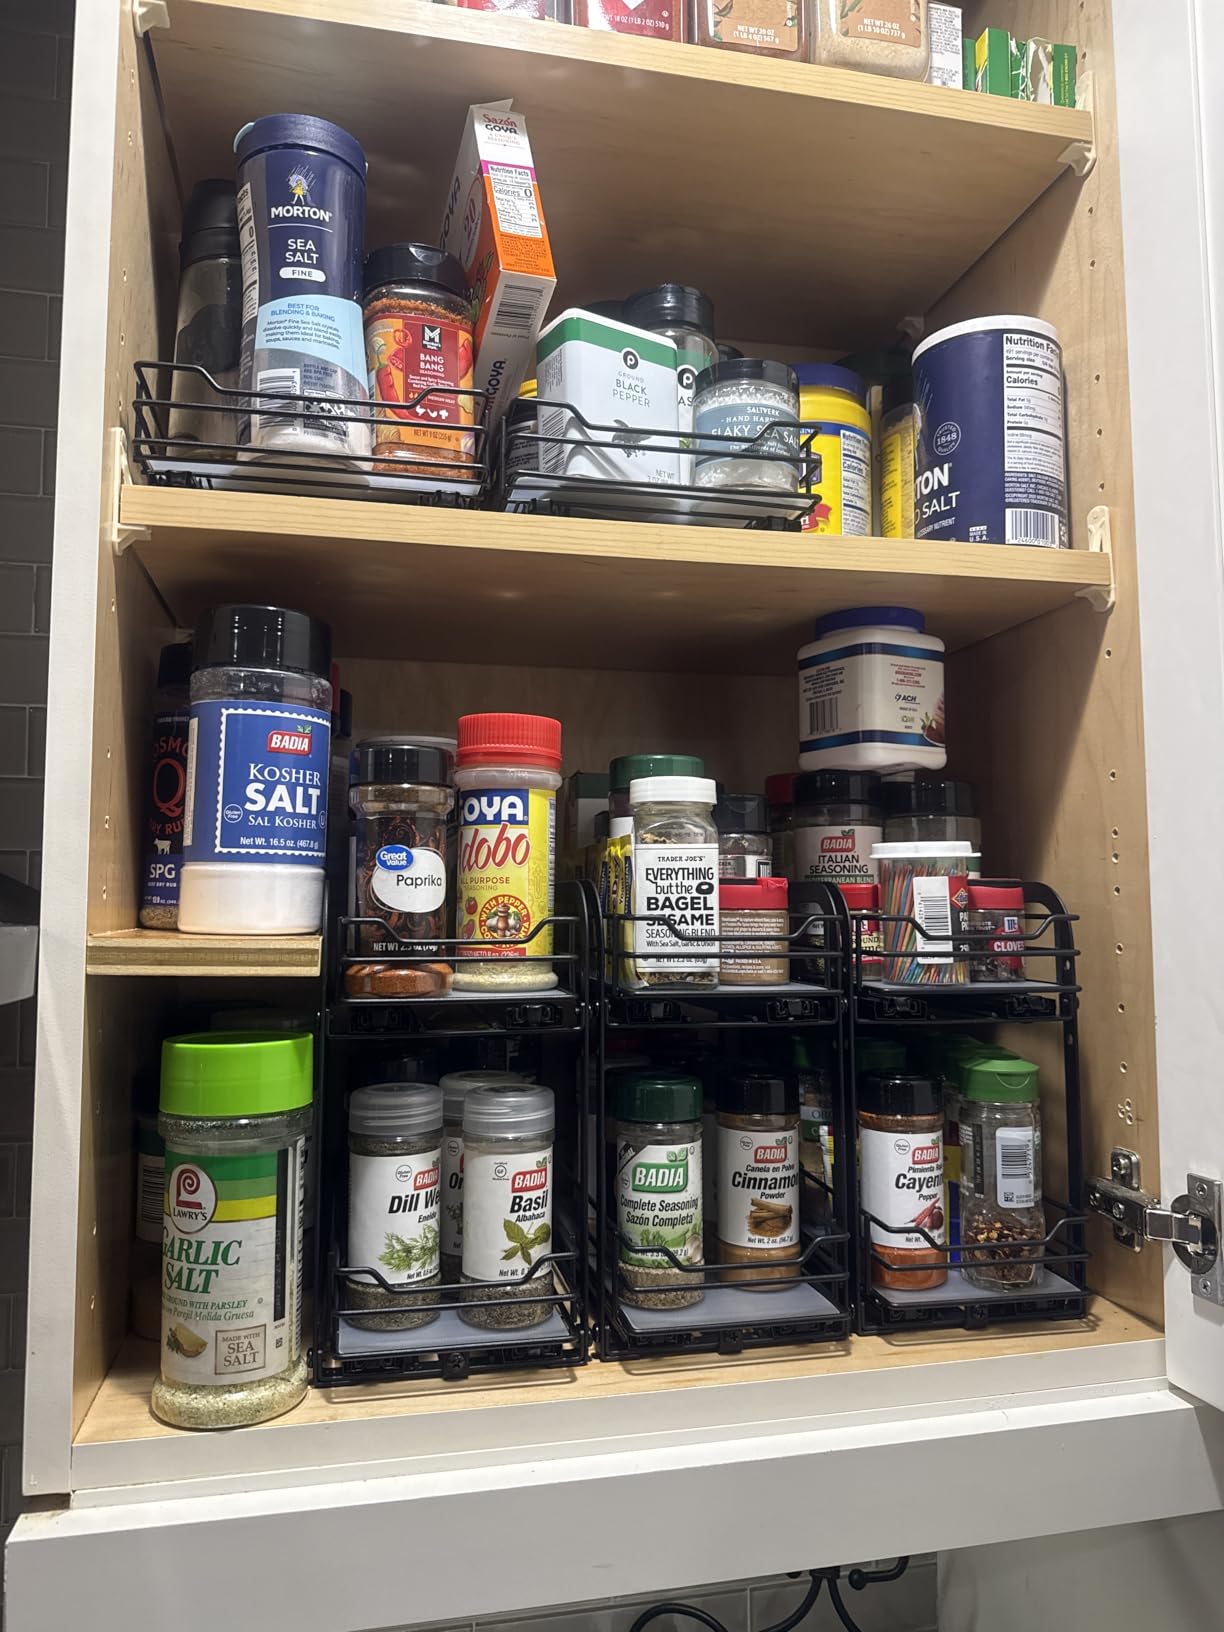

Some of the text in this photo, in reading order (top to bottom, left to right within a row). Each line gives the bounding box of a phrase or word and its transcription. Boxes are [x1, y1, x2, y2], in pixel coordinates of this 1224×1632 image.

[863, 18, 900, 30] NET WT OZ
[482, 113, 518, 128] Sazón
[485, 123, 519, 135] GOYA
[490, 166, 529, 177] Nutrition Facts
[494, 185, 533, 199] Calories 0
[271, 206, 331, 222] MORTON
[287, 238, 316, 252] SEA
[285, 251, 319, 265] SALT
[291, 269, 314, 278] FINE
[311, 311, 336, 322] BAKING
[1005, 335, 1045, 351] Nutrition
[420, 353, 444, 364] BANG
[1015, 349, 1033, 357] servings
[420, 362, 444, 372] BANG
[485, 360, 506, 396] GOYA
[618, 370, 645, 384] GROUND
[1006, 376, 1038, 386] Calories
[615, 378, 647, 396] BLACK
[612, 388, 650, 408] PEPPER
[746, 406, 780, 417] SALTVERK
[1018, 413, 1044, 421] Carbohydrate
[726, 415, 750, 423] HAND
[937, 424, 957, 437] TRUSTED
[937, 432, 958, 446] 1848
[655, 468, 666, 478] NET
[842, 461, 864, 475] Calories
[915, 463, 949, 500] TON
[922, 490, 961, 519] SALT
[933, 516, 956, 530] NUTRIENT
[969, 535, 989, 543] U.S.A.
[271, 733, 309, 752] BADIA
[248, 763, 321, 786] KOSHER
[152, 757, 187, 818] Q
[244, 782, 321, 816] SALT
[463, 795, 524, 821] OYA
[248, 814, 317, 830] SAL KOSHER
[240, 836, 254, 846] Net
[254, 837, 267, 846] Wt.
[269, 838, 286, 847] 16.5
[286, 839, 296, 847] oz.
[459, 822, 530, 874] dobo
[822, 839, 852, 849] BADIA
[380, 850, 407, 861] Great
[818, 854, 860, 864] ITALIAN
[149, 863, 176, 879] SPG
[645, 867, 714, 881] EVERYTHING
[809, 864, 869, 874] SEASONING
[396, 874, 442, 889] Paprika
[469, 876, 511, 885] PURPOSE
[655, 881, 693, 895] but the
[480, 895, 527, 921] WITH PEPPER
[646, 896, 714, 911] BAGEL
[646, 928, 716, 939] SEASONG BLEND
[373, 942, 399, 951] NET WT
[669, 940, 681, 948] Salt,
[993, 941, 1024, 952] CLOVES
[756, 1148, 786, 1160] BADIA
[914, 1147, 939, 1161] BADIA
[745, 1164, 770, 1173] Canela
[771, 1165, 780, 1173] en
[907, 1166, 935, 1174] Pimienta
[448, 1172, 464, 1190] Or
[514, 1171, 546, 1189] BADIA
[634, 1167, 684, 1187] BADIA
[388, 1187, 440, 1214] Dill We
[509, 1189, 548, 1214] Basil
[760, 1191, 786, 1200] Powder
[918, 1193, 938, 1202] Pepper
[620, 1194, 699, 1212] Complete Seasoning
[172, 1208, 208, 1221] LAWRY'S
[515, 1211, 546, 1223] Albahaca
[625, 1211, 694, 1229] Sazón Completa
[164, 1261, 219, 1294] SALT
[406, 1270, 415, 1280] Net
[498, 1269, 520, 1277] Net Wt.
[188, 1300, 208, 1310] WITH
[210, 1299, 248, 1310] PARSLEY
[194, 1309, 222, 1321] Molida
[223, 1309, 254, 1321] Gruesa
[221, 1332, 260, 1343] MADE WITH
[227, 1340, 255, 1355] SEA
[223, 1351, 260, 1368] SALT
